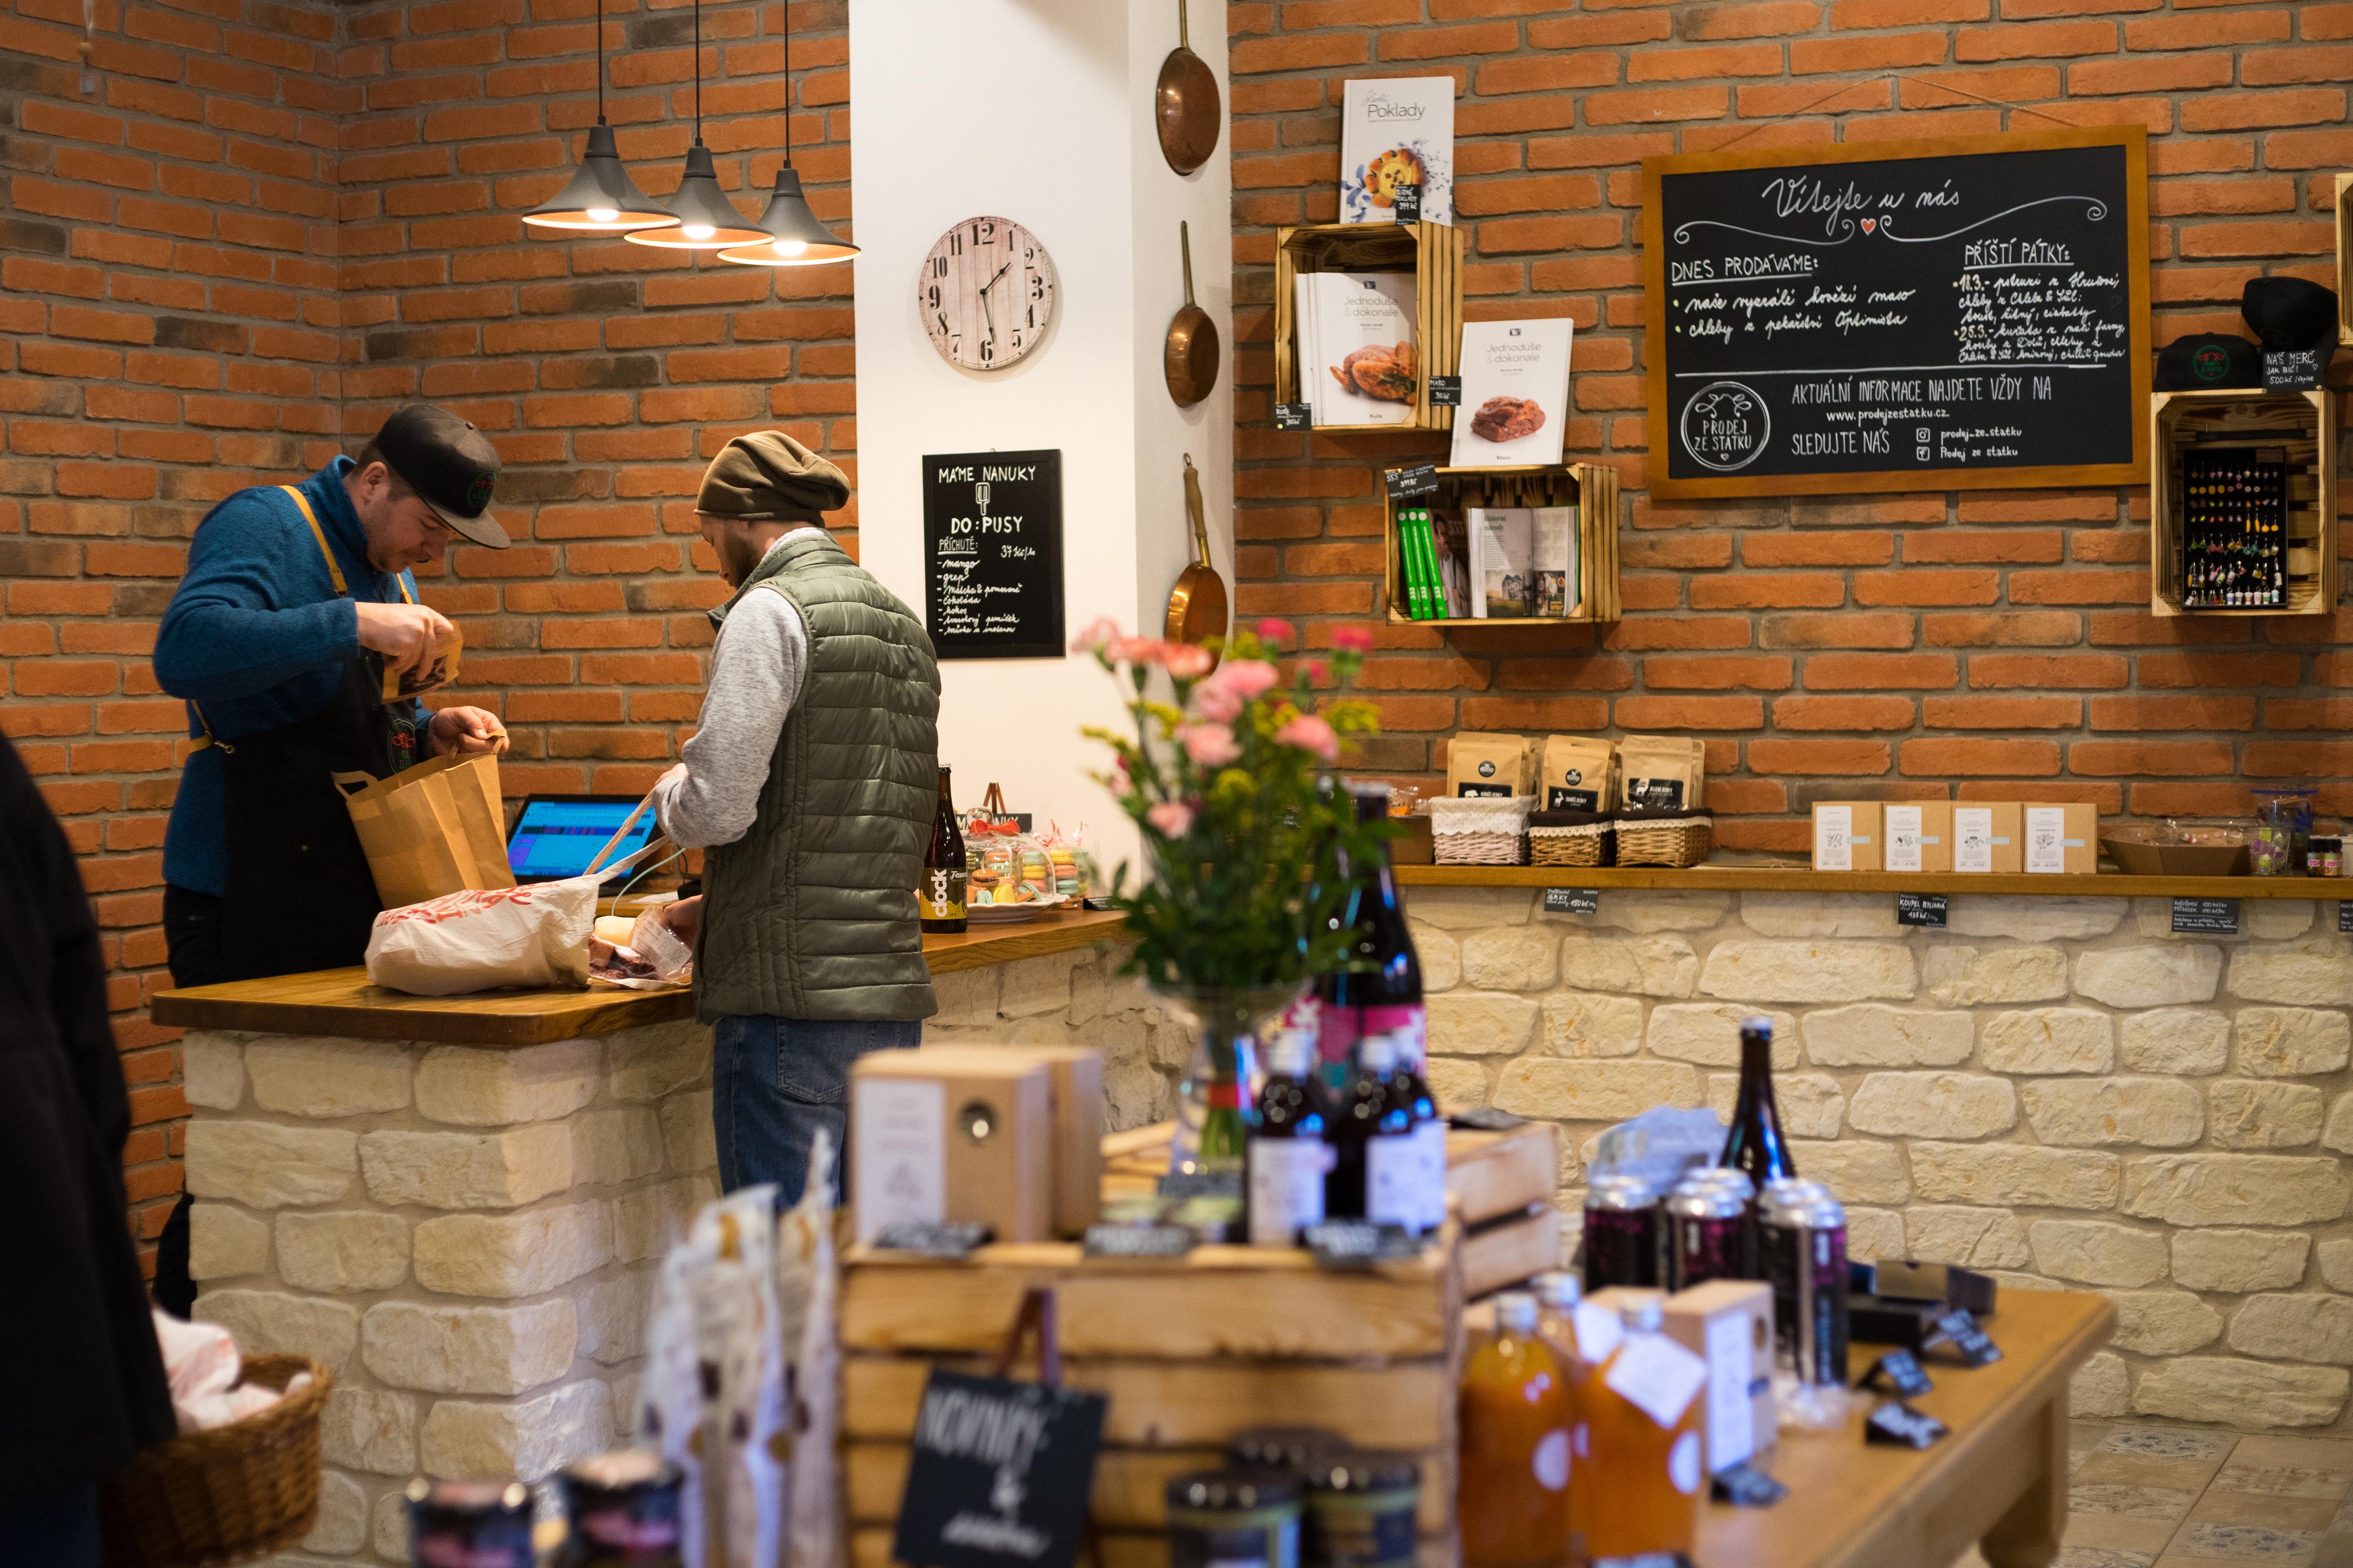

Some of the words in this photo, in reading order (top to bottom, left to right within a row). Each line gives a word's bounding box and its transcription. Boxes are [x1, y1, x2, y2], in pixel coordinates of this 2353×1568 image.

[1368, 102, 1426, 121] Poklady
[1762, 175, 1872, 236] Vítejte
[1915, 179, 1959, 208] nás
[949, 233, 962, 255] 11
[1008, 230, 1013, 251] 1
[972, 222, 994, 246] 12
[1965, 238, 2017, 265] PŘÍŠTÍ
[2022, 238, 2070, 263] PÁTKY:
[932, 256, 947, 278] 10
[1025, 248, 1034, 269] 2
[1671, 259, 1714, 282] DNES
[1725, 253, 1819, 276] PRODÁVÁME:
[929, 285, 940, 309] 9
[1032, 276, 1043, 300] 3
[1344, 296, 1398, 305] Jednoduše
[1685, 293, 1727, 313] naše
[1868, 289, 1916, 304] maso
[2046, 291, 2053, 302] &
[938, 312, 948, 335] 8
[1025, 304, 1035, 328] 4
[1353, 308, 1398, 316] dokonale
[1689, 318, 1733, 345] chleby
[1745, 321, 1755, 332] z
[952, 334, 961, 353] 7
[980, 339, 993, 361] 6
[1012, 329, 1021, 348] 5
[1487, 342, 1541, 353] Jednoduše
[1494, 353, 1540, 363] dokonale
[2267, 352, 2285, 365] NÁŠ
[2289, 350, 2315, 365] MERČ
[1791, 375, 1853, 405] AKTUÁLNÍ
[1859, 379, 1923, 402] INFORMACE
[1929, 378, 1983, 401] NAJDETE
[1991, 373, 2022, 401] VŽDY
[2033, 376, 2052, 400] NA
[1702, 419, 1747, 435] PRODEJ
[1694, 436, 1708, 452] ZE
[1712, 435, 1752, 452] STATKU
[1791, 431, 1857, 456] SLEDUJTE
[1863, 428, 1889, 453] NÁS
[1972, 448, 1981, 457] ze
[1987, 446, 2018, 457] statku
[939, 466, 974, 483] MÁME
[983, 466, 1035, 481] NANUKY
[942, 559, 980, 575] mango
[943, 573, 969, 588] grep
[943, 605, 967, 616] kokos
[1899, 899, 1920, 907] KOUPEL
